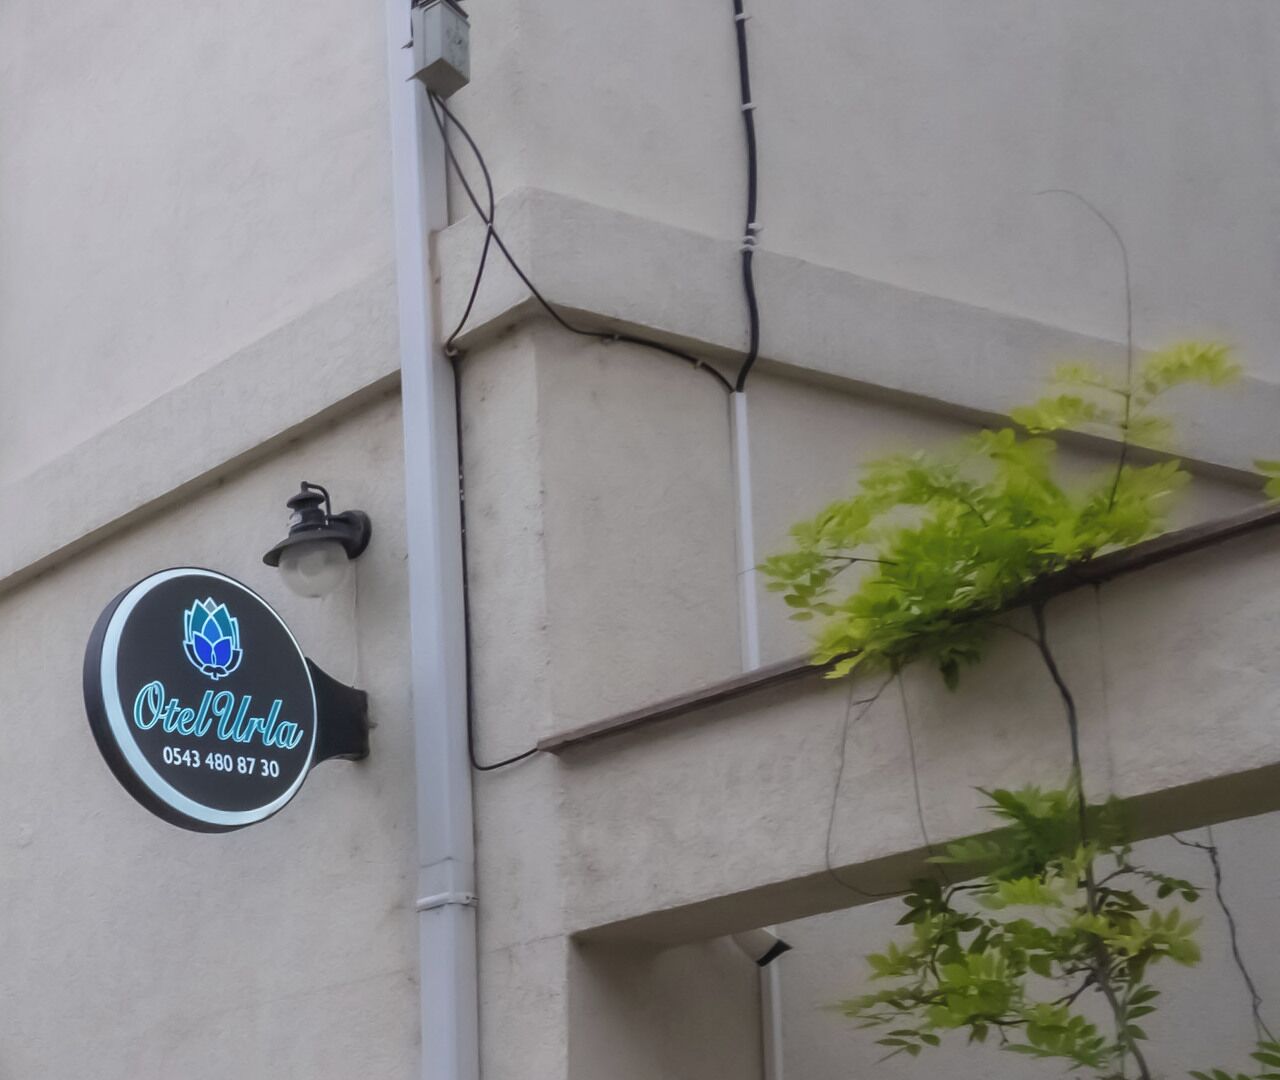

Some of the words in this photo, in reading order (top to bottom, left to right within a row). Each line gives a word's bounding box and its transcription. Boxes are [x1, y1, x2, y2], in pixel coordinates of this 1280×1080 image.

[133, 680, 213, 737] Otel
[212, 690, 304, 750] Urla
[162, 746, 201, 768] 0543
[204, 752, 233, 773] 480
[237, 757, 256, 775] 87
[260, 759, 280, 778] 30
